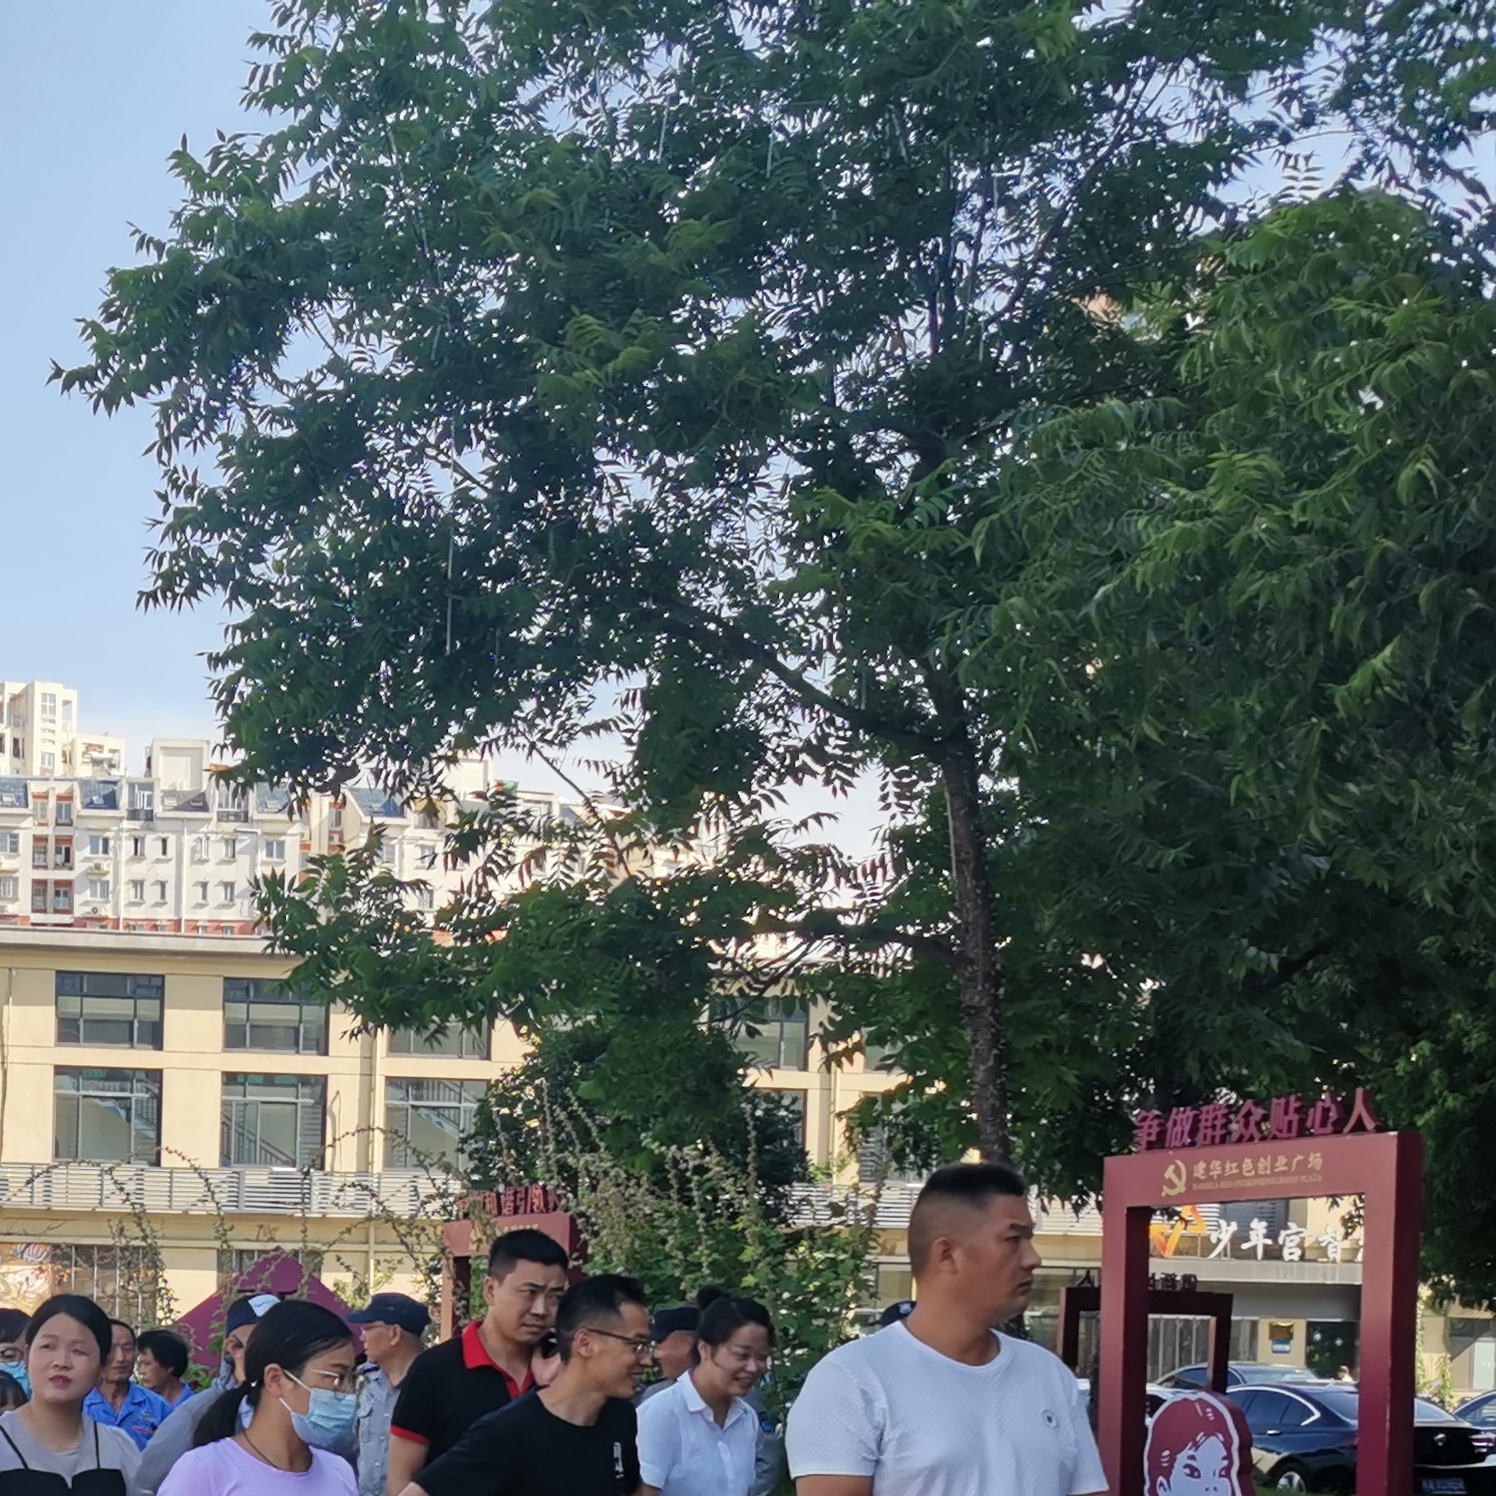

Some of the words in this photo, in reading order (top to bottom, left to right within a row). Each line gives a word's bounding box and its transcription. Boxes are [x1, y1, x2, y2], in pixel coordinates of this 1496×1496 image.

[1133, 1087, 1380, 1150] 争做群众贴心人
[1192, 1151, 1324, 1181] 建华红色创业广场
[1208, 1217, 1364, 1263] 少年宫智
